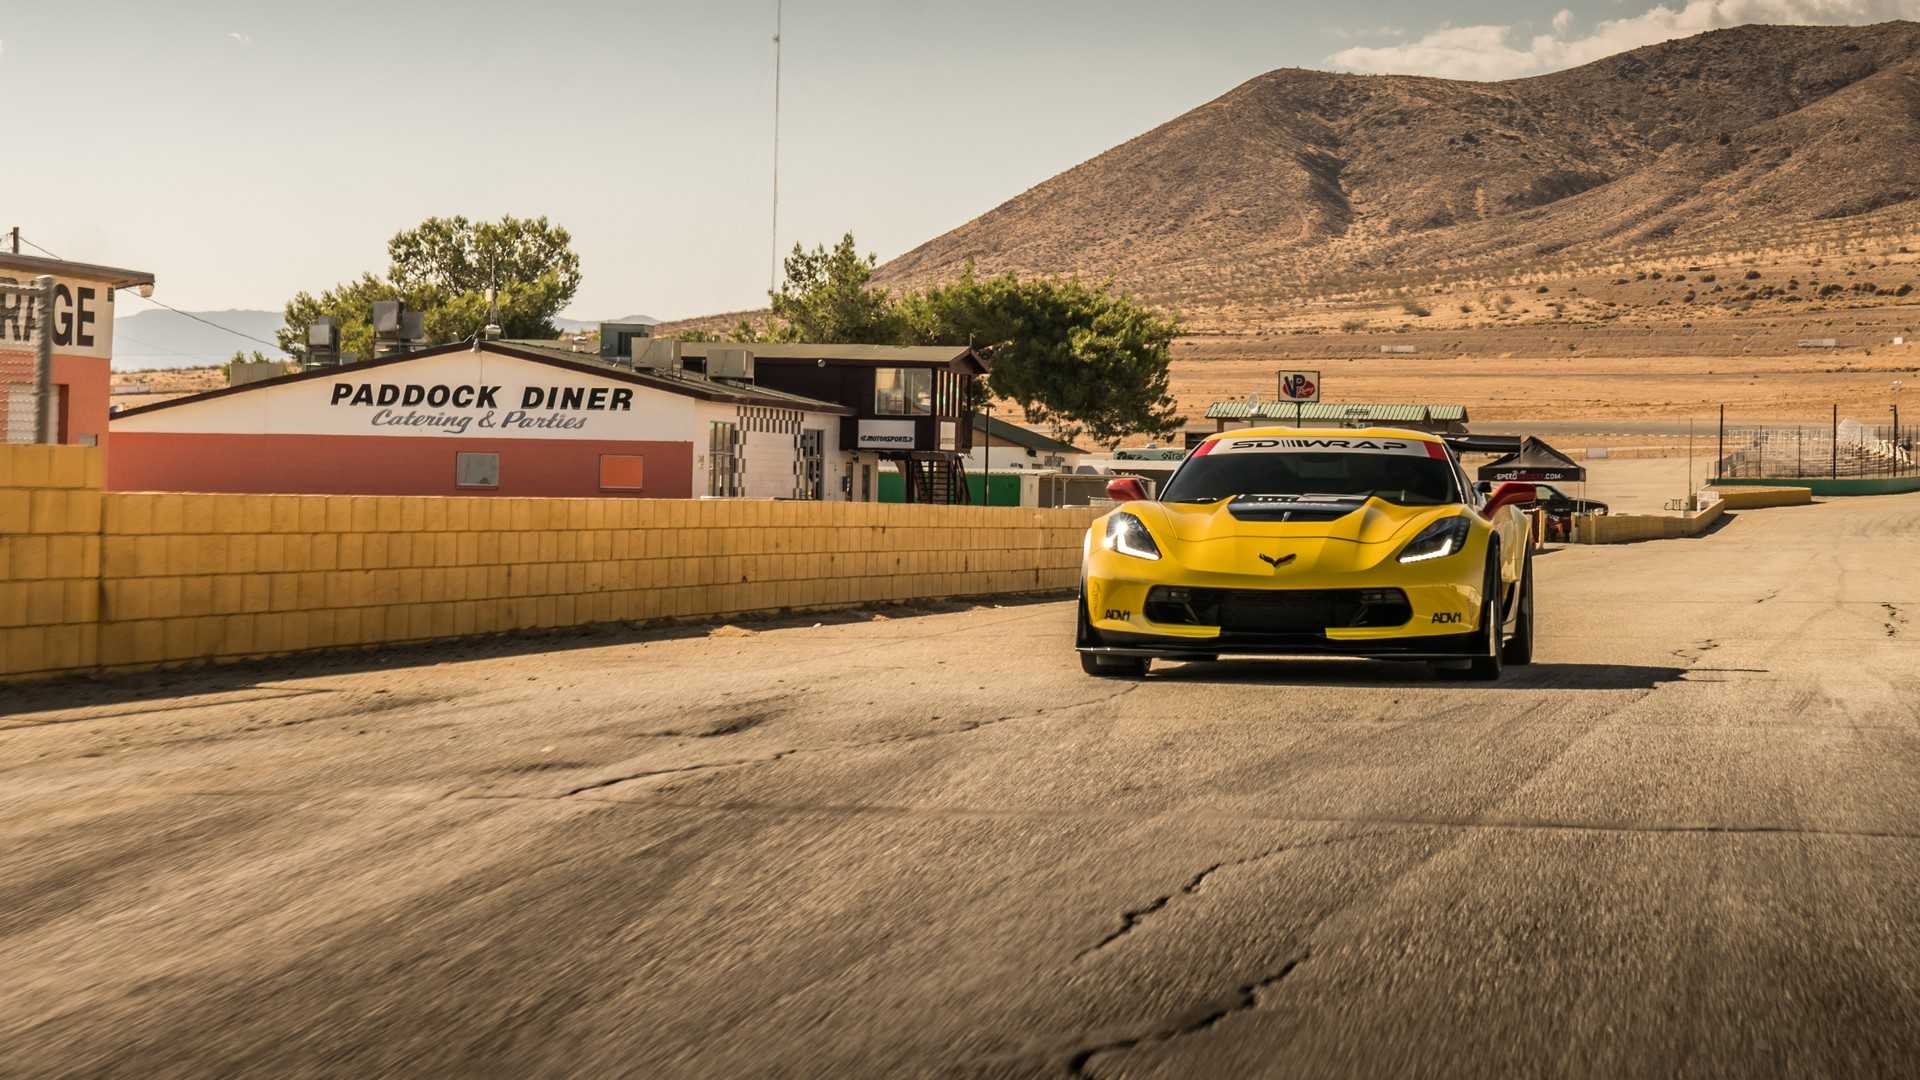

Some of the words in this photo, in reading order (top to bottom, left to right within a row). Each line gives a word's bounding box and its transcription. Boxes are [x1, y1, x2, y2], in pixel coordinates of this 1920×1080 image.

[330, 383, 502, 408] PADDOCK
[521, 386, 634, 411] DINER
[371, 409, 473, 433] Catering
[478, 410, 496, 428] &
[501, 411, 587, 429] Parties
